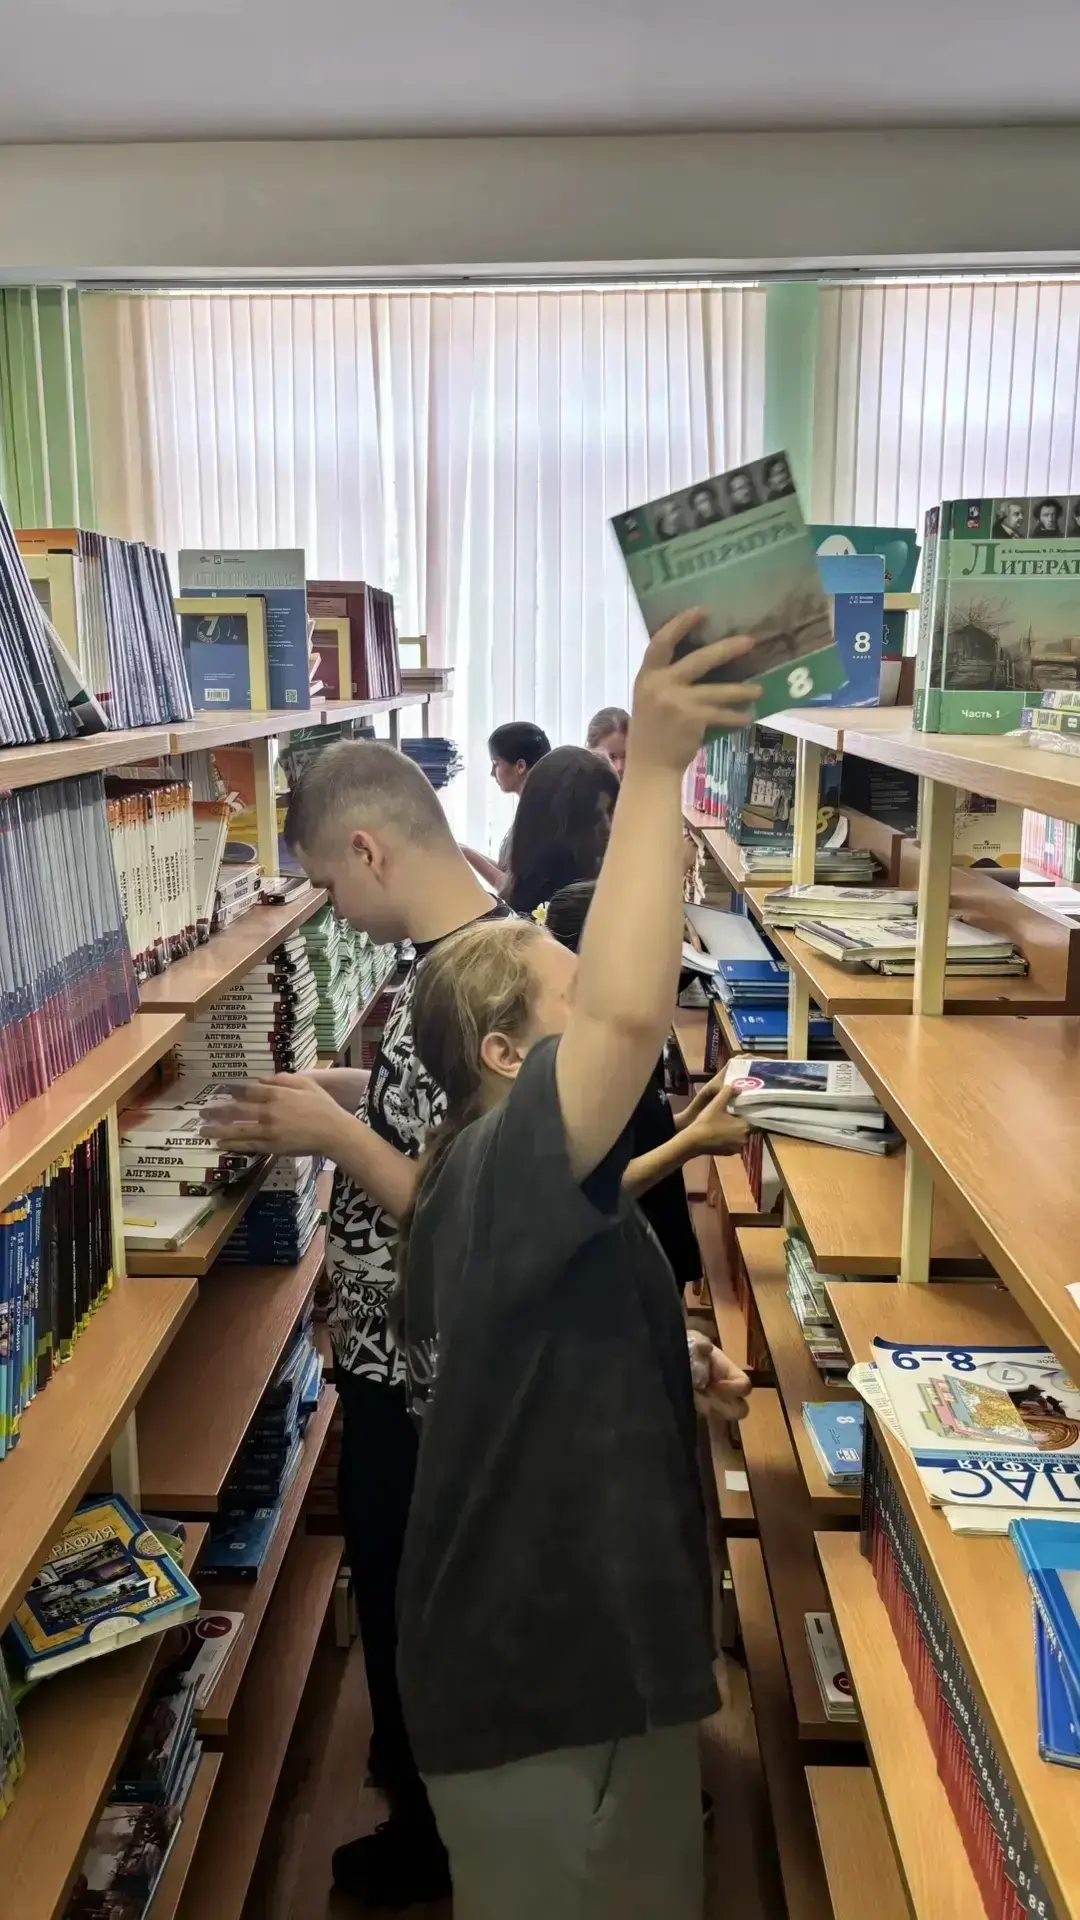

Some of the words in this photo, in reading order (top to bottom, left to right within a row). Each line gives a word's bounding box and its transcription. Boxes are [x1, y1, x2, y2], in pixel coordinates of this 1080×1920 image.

[854, 632, 871, 652] 8
[787, 666, 814, 699] 8
[962, 709, 992, 719] Часть
[995, 709, 1001, 719] 1
[165, 1138, 211, 1146] АЛГЕБРА
[138, 1157, 184, 1165] АЛГЕБРА
[125, 1169, 171, 1178] АЛГЕБРА
[136, 1576, 159, 1598] 7
